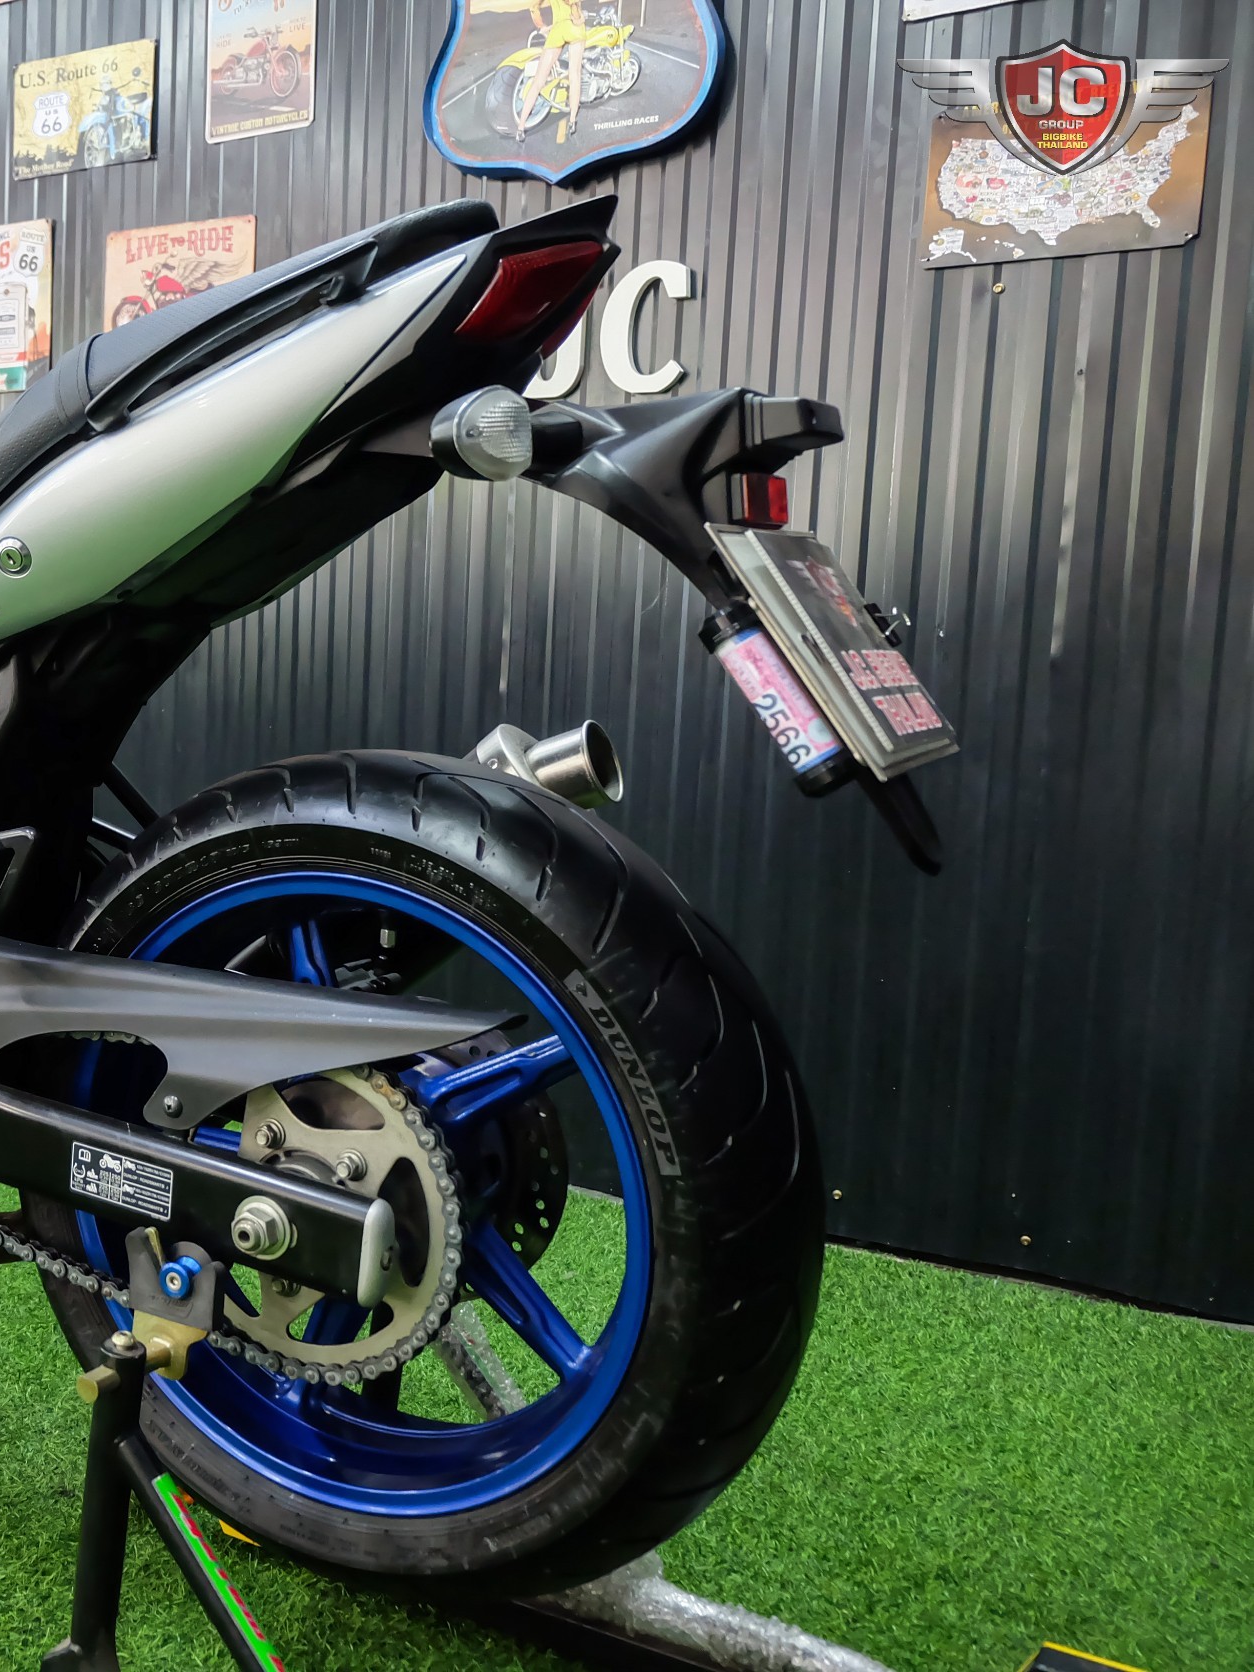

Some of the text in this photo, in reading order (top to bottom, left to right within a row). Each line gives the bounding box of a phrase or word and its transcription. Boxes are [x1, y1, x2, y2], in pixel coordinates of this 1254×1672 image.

[19, 57, 118, 89] U.S. Route 66
[38, 95, 65, 108] ROUTE
[41, 117, 62, 134] 66
[211, 110, 308, 136] VINTAGE CUSTOM MOTORCYCLES
[594, 115, 659, 130] THRILLING RACES
[21, 231, 45, 243] ROUTE
[126, 225, 234, 264] LIVE TO RIDE
[19, 253, 39, 272] 66
[752, 693, 811, 765] 2566
[588, 1006, 677, 1166] DUNLOP
